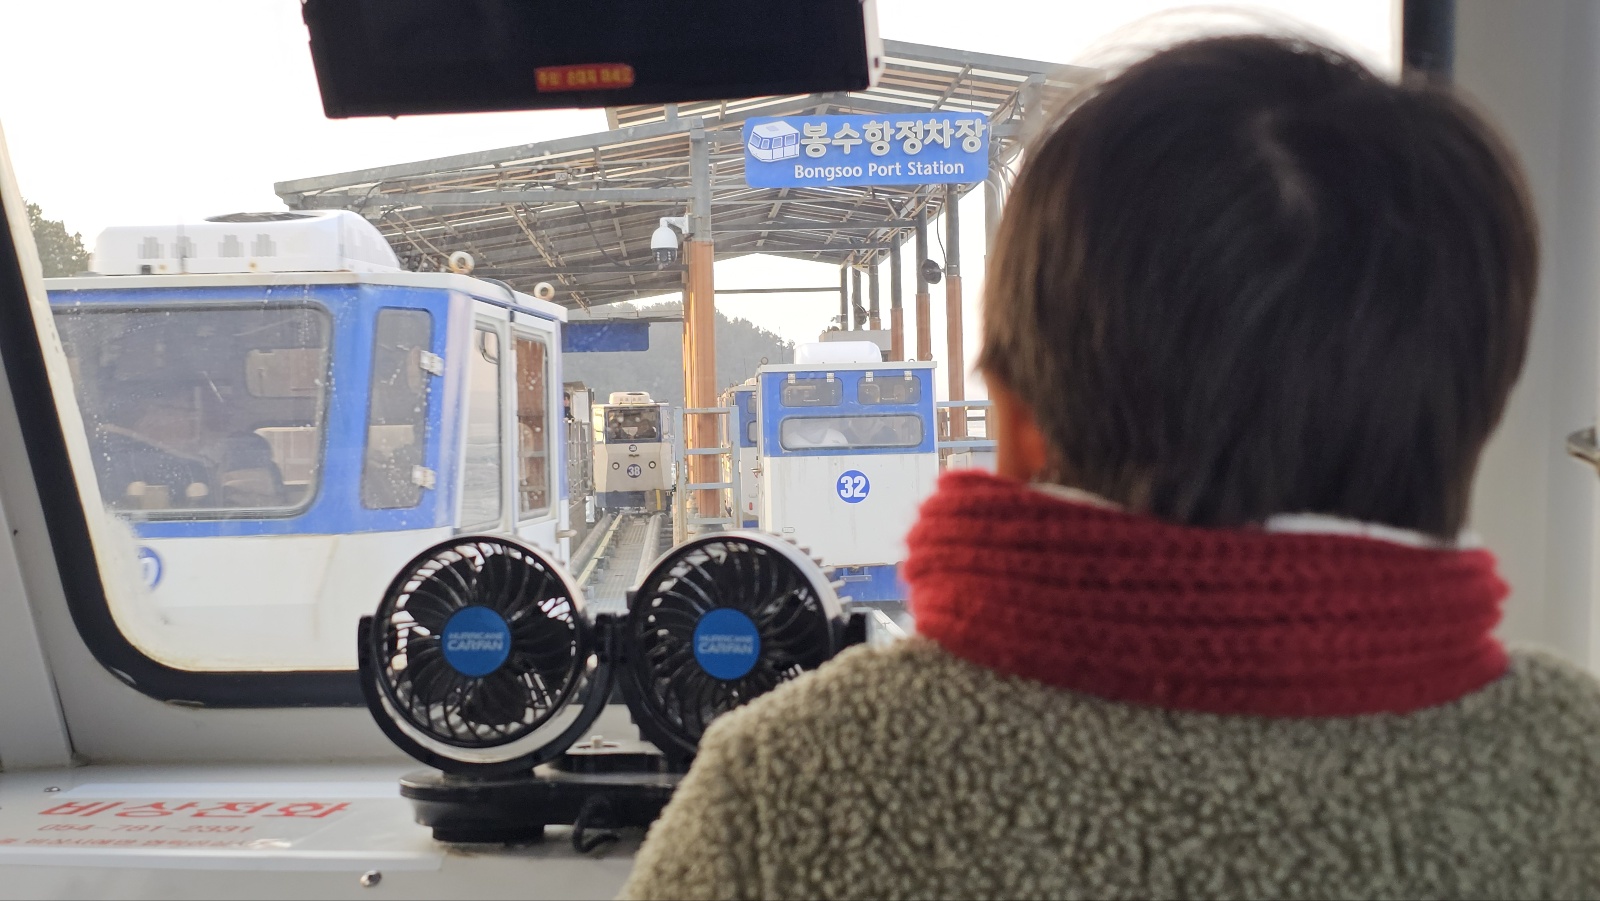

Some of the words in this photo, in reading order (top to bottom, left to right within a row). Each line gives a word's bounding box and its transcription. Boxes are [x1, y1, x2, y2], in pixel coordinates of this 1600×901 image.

[801, 118, 987, 158] 봉수항정차장
[794, 164, 863, 182] Bongsoo
[868, 161, 902, 177] Port
[907, 160, 965, 175] Station
[628, 466, 641, 477] 38
[840, 475, 866, 498] 32
[38, 801, 351, 818] 비상전화
